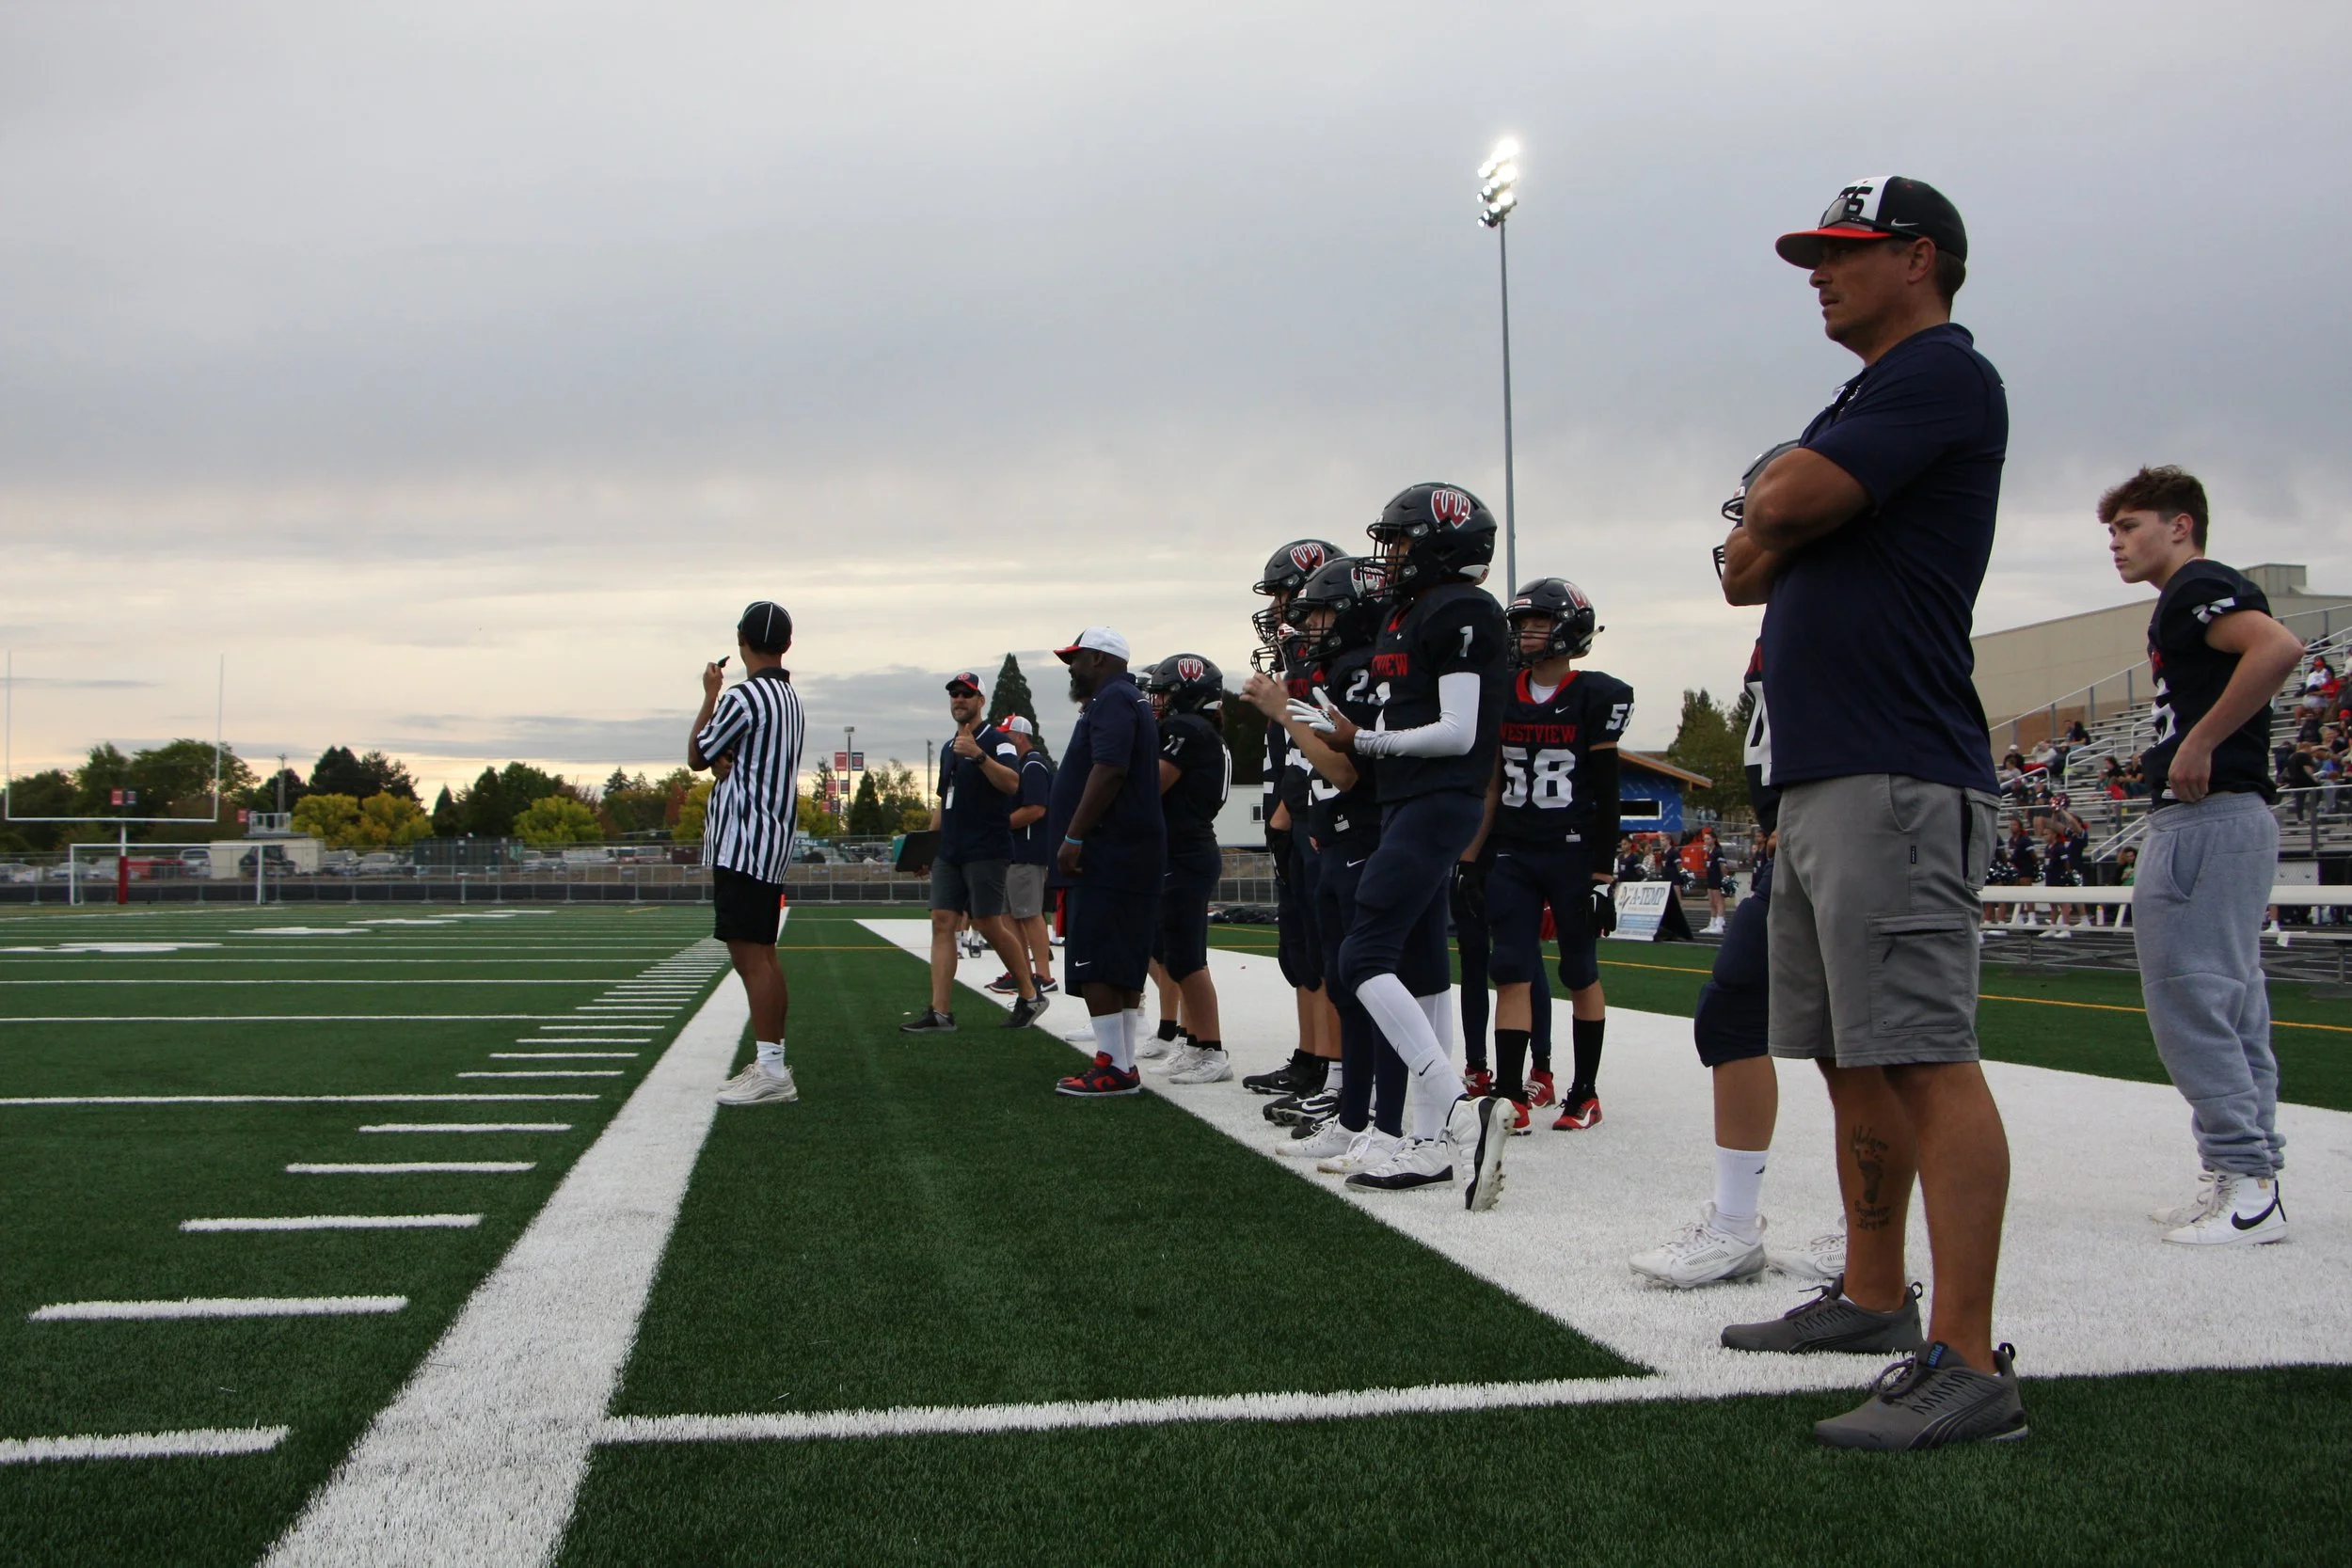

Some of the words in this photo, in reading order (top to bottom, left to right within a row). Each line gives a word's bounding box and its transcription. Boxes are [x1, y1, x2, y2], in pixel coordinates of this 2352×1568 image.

[1459, 626, 1473, 657] 1
[1500, 723, 1578, 743] WESTVIEW
[1502, 745, 1576, 809] 58
